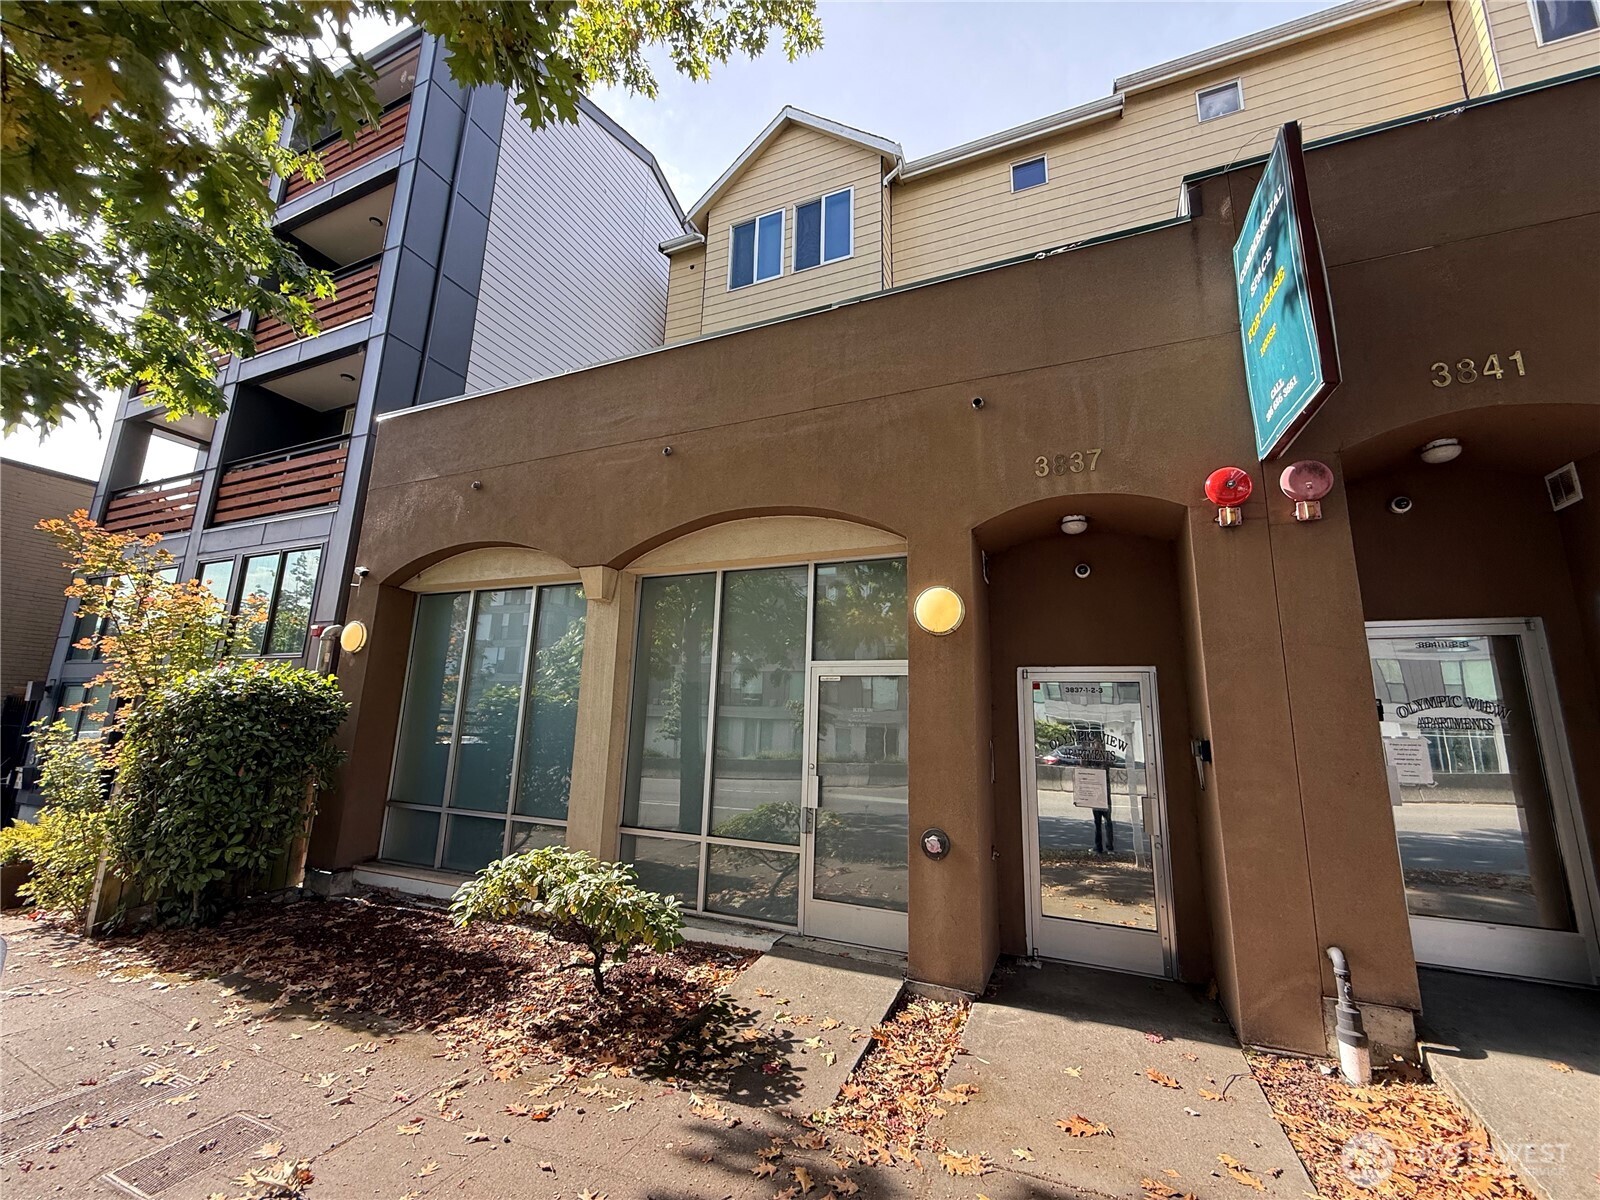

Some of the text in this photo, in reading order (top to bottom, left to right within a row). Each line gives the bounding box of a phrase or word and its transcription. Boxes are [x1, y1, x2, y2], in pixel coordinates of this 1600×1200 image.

[1240, 184, 1284, 285] COMMERCIAL
[1250, 246, 1272, 297] SPACE
[1247, 265, 1285, 345] FOR LEASE
[1431, 350, 1526, 388] 3841
[1034, 448, 1102, 477] 3837
[1396, 695, 1512, 720] OLYMPIC VIEW
[1417, 716, 1496, 731] APARTMENTS
